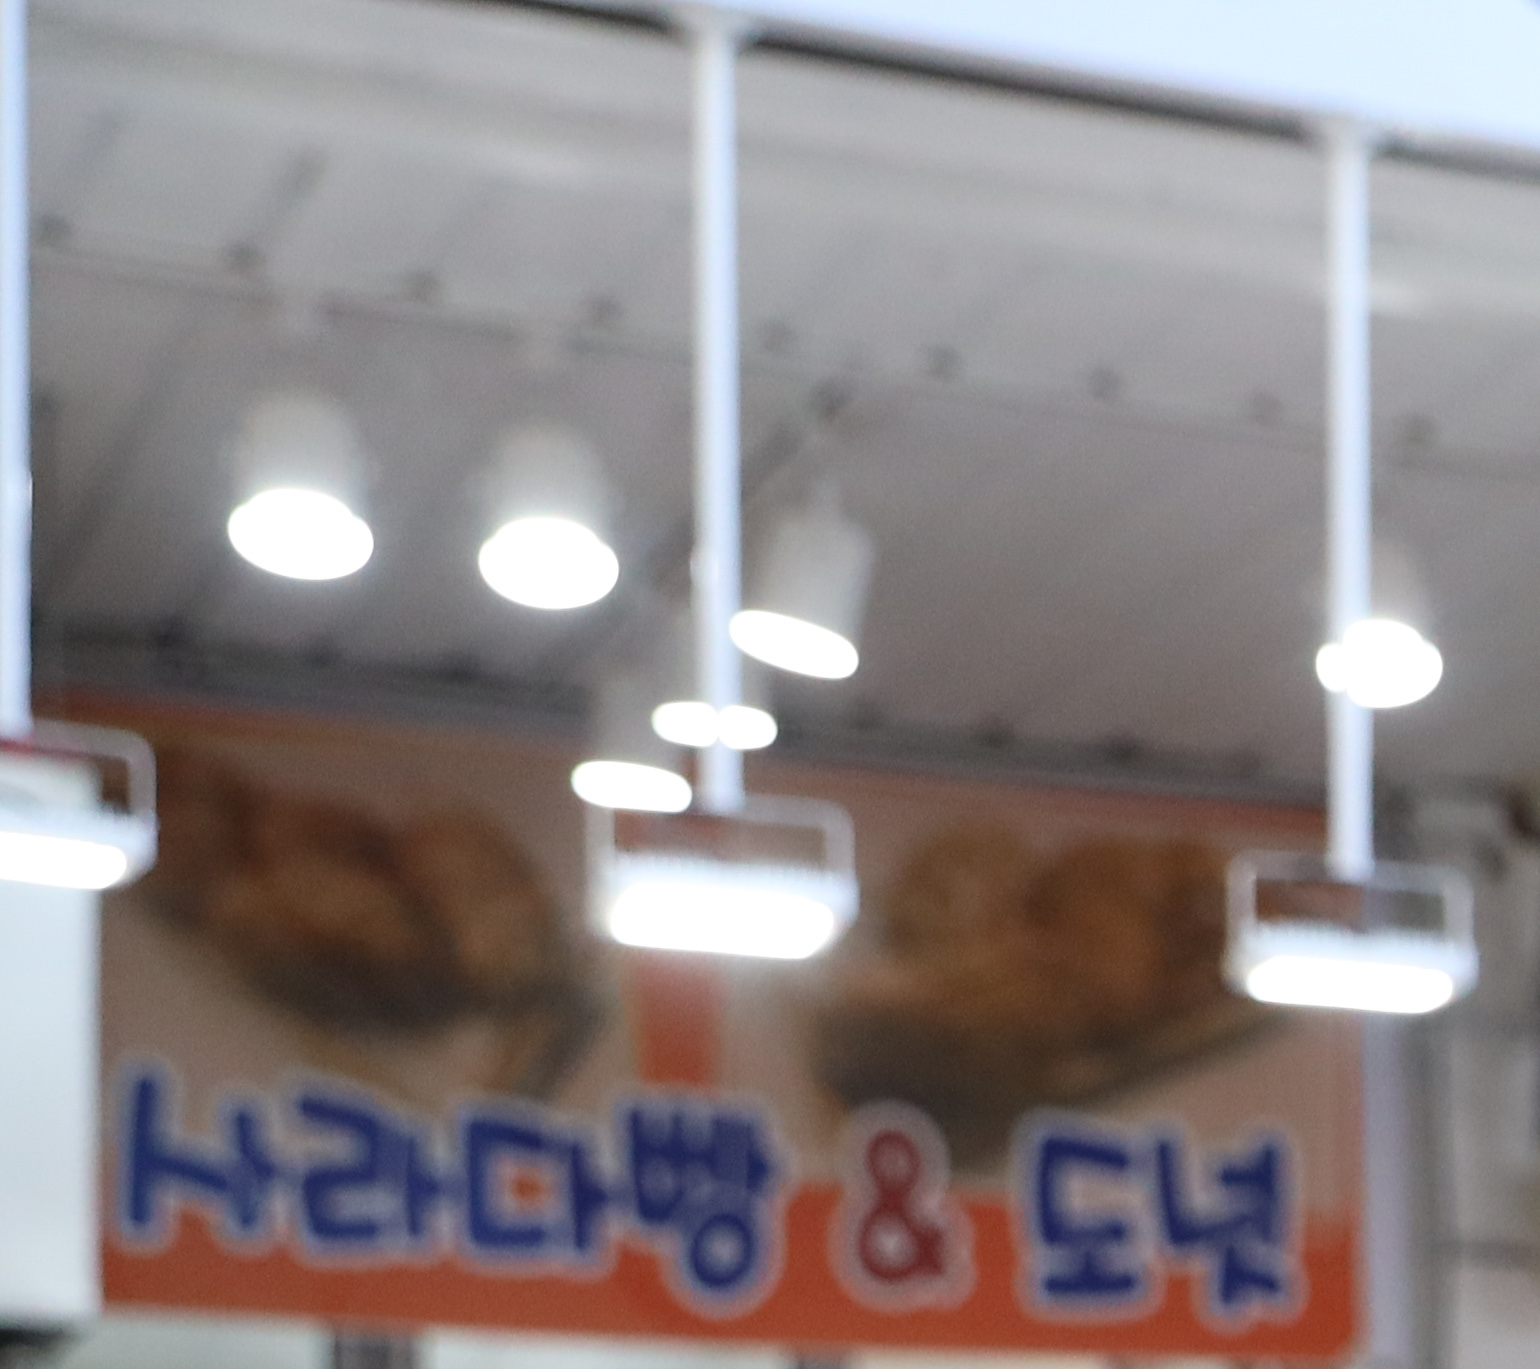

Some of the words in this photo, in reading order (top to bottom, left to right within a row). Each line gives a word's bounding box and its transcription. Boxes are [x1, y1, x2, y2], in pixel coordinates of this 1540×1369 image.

[120, 1072, 776, 1293] 사라다빵
[857, 1128, 950, 1284] &
[1040, 1134, 1284, 1306] 도넛
